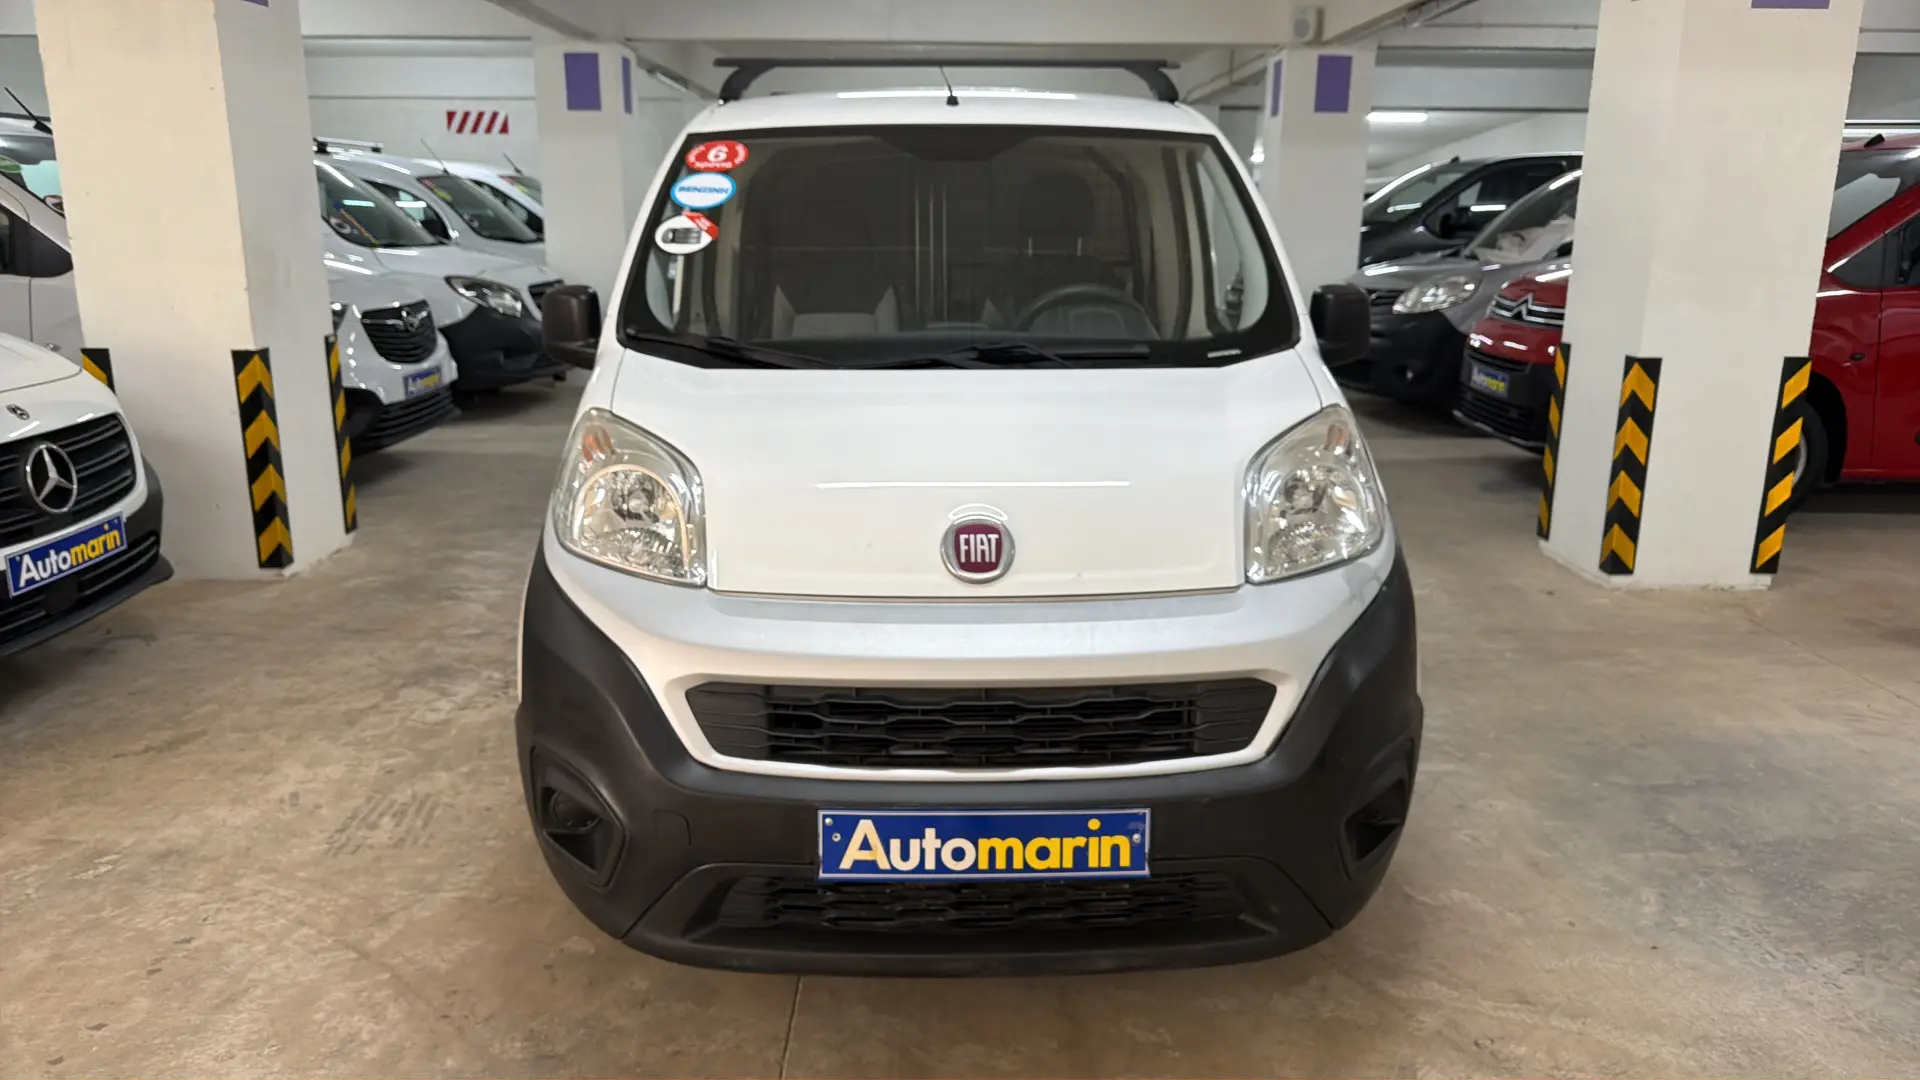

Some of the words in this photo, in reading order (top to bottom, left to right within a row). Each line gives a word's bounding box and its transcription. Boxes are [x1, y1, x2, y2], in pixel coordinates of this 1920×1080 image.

[706, 144, 729, 163] 6
[19, 522, 121, 588] Automarin
[959, 533, 1000, 563] FIAT
[838, 818, 1131, 871] Automarin
